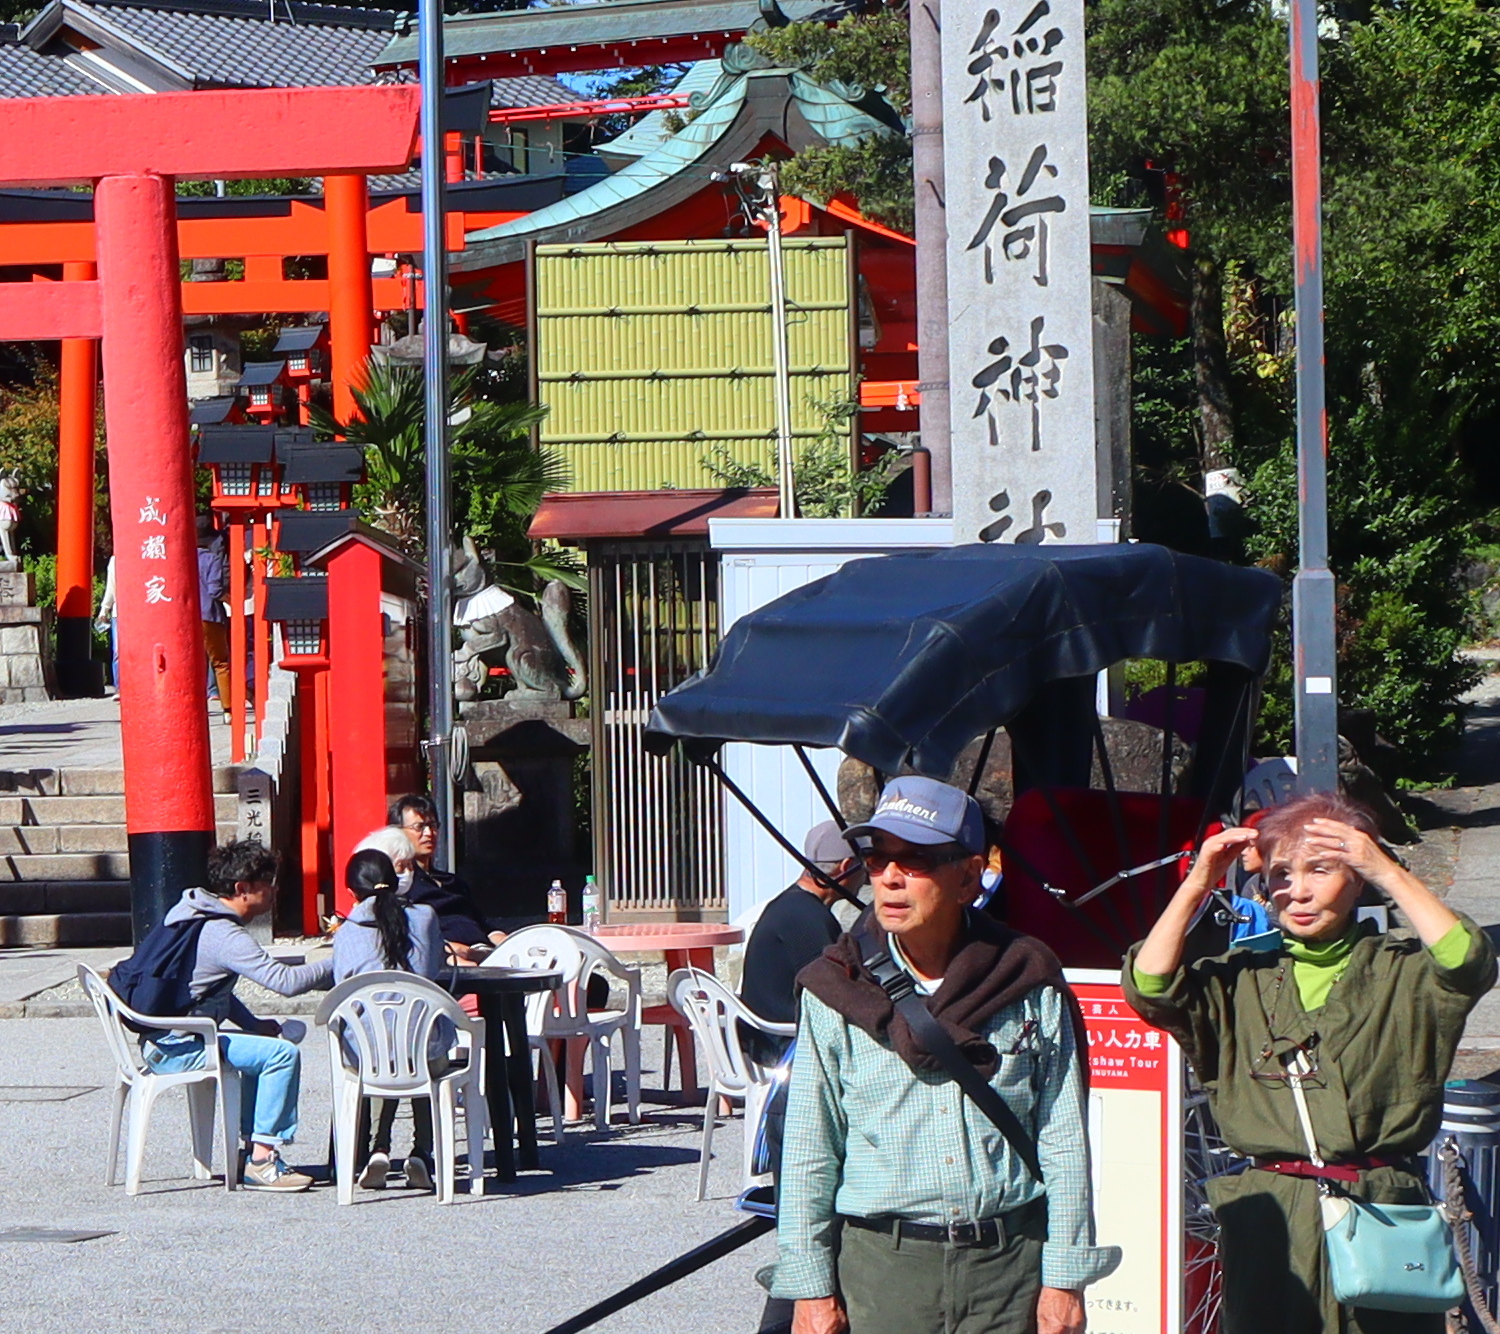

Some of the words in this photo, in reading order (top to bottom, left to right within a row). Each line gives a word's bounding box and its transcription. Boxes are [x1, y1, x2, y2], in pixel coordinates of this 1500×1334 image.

[1130, 1056, 1159, 1068] Tour
[1084, 1299, 1139, 1313] ってきます。
